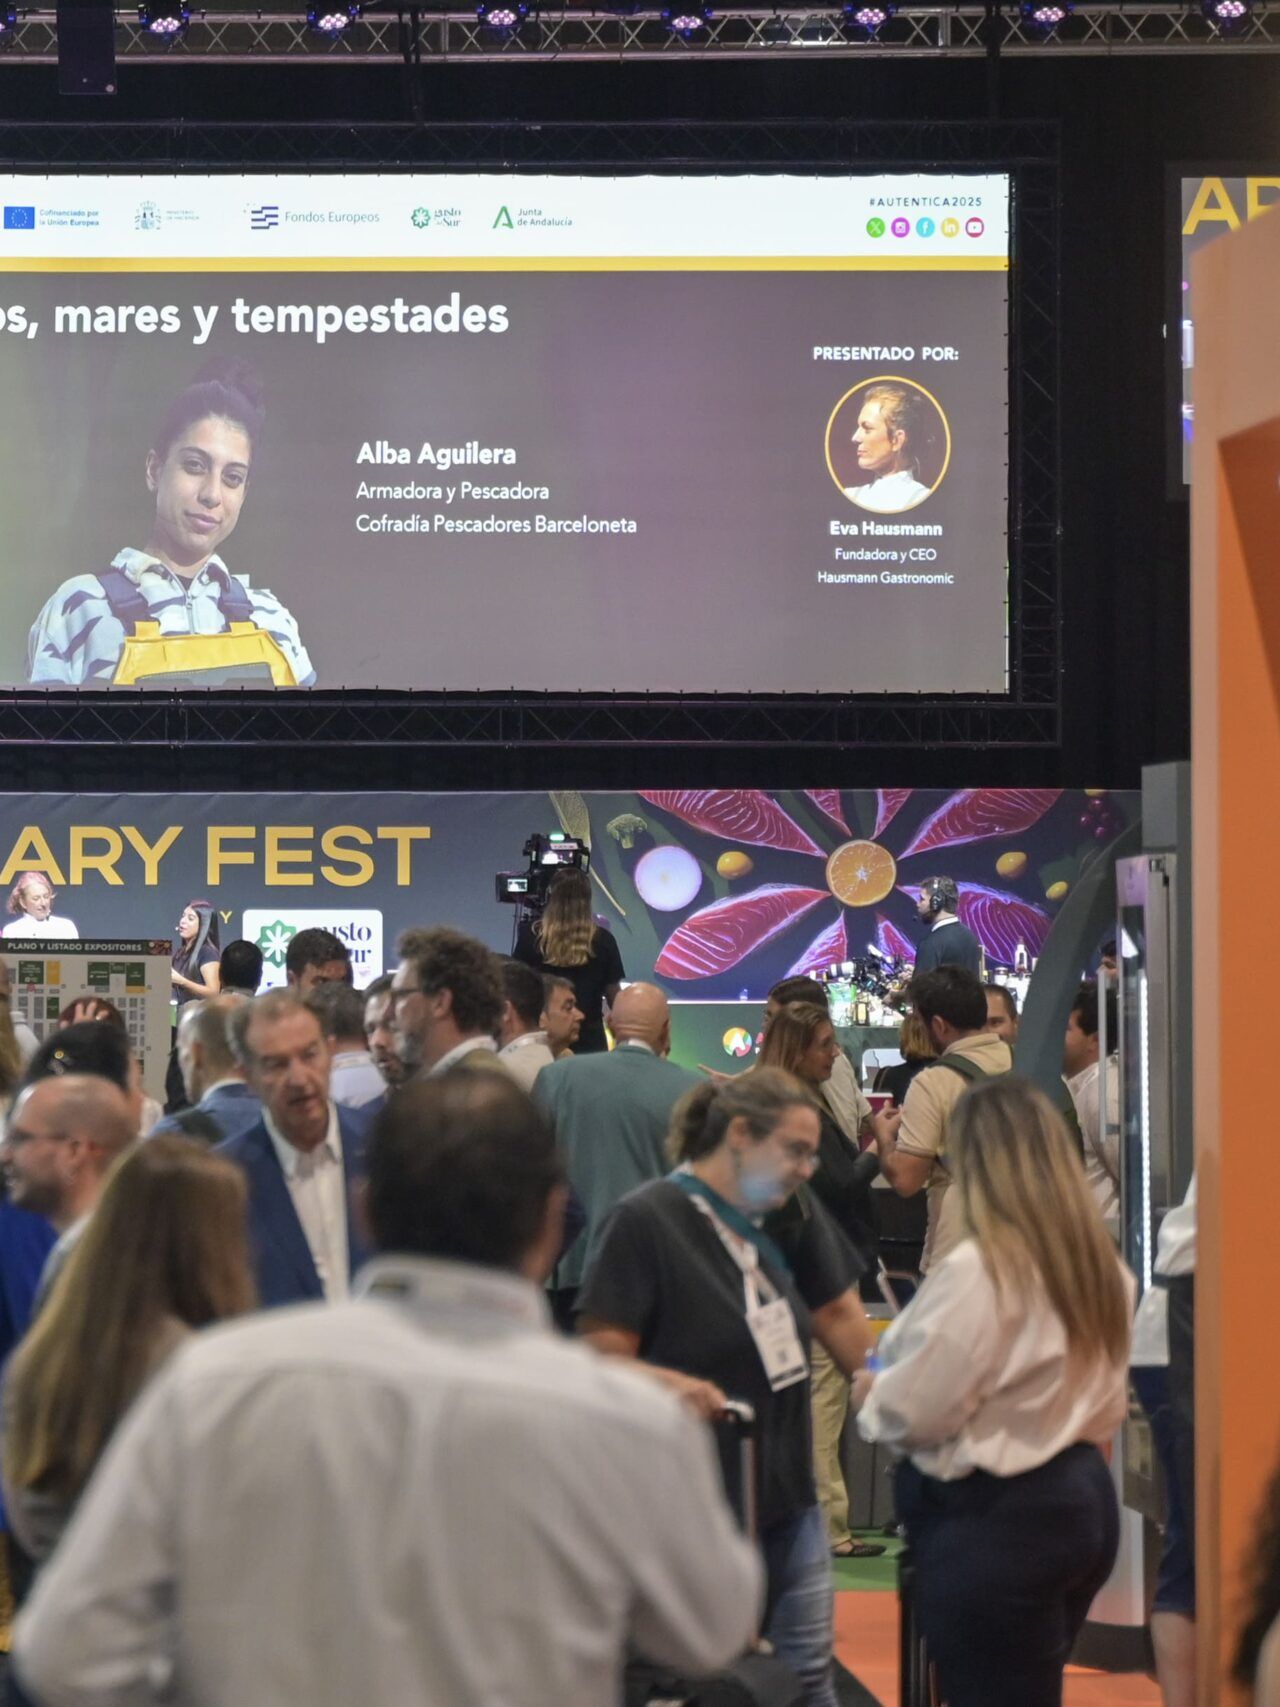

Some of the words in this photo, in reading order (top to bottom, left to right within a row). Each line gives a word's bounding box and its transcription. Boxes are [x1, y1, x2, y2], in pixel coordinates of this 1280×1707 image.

[869, 196, 983, 208] #AUTENTICA2025
[39, 208, 85, 217] Cofinanciado
[87, 210, 99, 218] por
[284, 211, 325, 223] Fondos
[328, 211, 380, 225] Europeos
[517, 208, 542, 217] Junta
[47, 218, 69, 226] Unión
[70, 218, 100, 228] Europea
[517, 218, 528, 226] de
[530, 218, 573, 226] Andalucía
[55, 304, 181, 334] mares
[193, 306, 219, 344] y
[231, 294, 510, 344] tempestades
[813, 346, 915, 361] PRESENTADO
[922, 346, 960, 361] POR:
[356, 441, 411, 465] Alba
[417, 441, 517, 471] Aguilera
[356, 481, 442, 500] Armadora
[446, 486, 456, 504] y
[461, 481, 550, 500] Pescadora
[356, 514, 430, 533] Cofradía
[434, 514, 532, 533] Pescadores
[535, 515, 638, 534] Barceloneta
[829, 520, 858, 536] Eva
[862, 520, 944, 537] Hausmann
[834, 547, 898, 561] Fundadora
[899, 551, 907, 564] y
[908, 548, 937, 561] CEO
[817, 571, 878, 584] Hausmann
[880, 571, 956, 585] Gastronomic
[206, 825, 431, 887] FEST
[219, 911, 233, 924] Y
[7, 942, 38, 950] PLANO
[47, 943, 83, 951] LISTADO
[84, 943, 143, 952] EXPOSITORES
